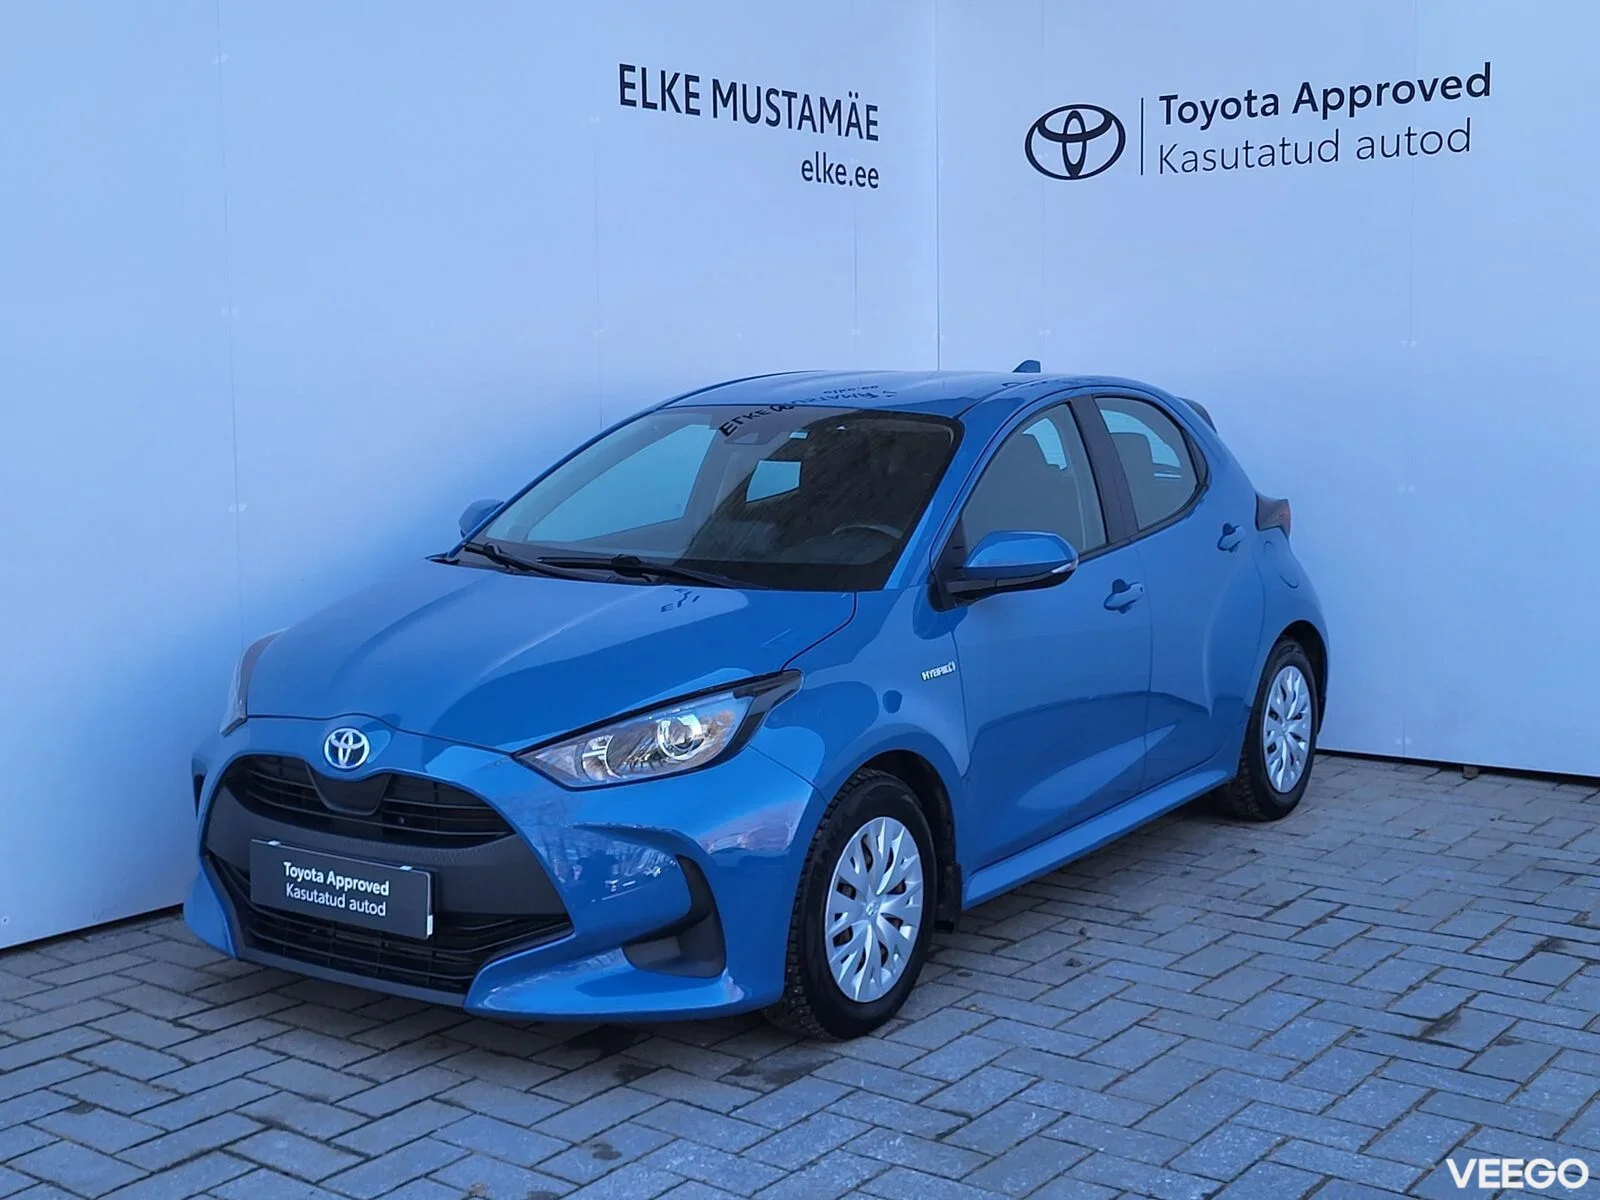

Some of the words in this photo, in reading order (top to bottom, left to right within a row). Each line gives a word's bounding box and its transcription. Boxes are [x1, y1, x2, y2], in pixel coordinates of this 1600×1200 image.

[619, 63, 701, 116] ELKE
[712, 78, 879, 142] MUSTAMÄE
[1159, 89, 1280, 131] Toyota
[1292, 61, 1492, 118] Approved
[801, 151, 880, 189] elke.ee
[1159, 128, 1340, 175] Kasutatud
[1356, 117, 1472, 160] autod
[283, 861, 325, 884] Toyota
[326, 870, 390, 897] Approved
[286, 882, 346, 909] Kasutatud
[349, 900, 387, 917] autod
